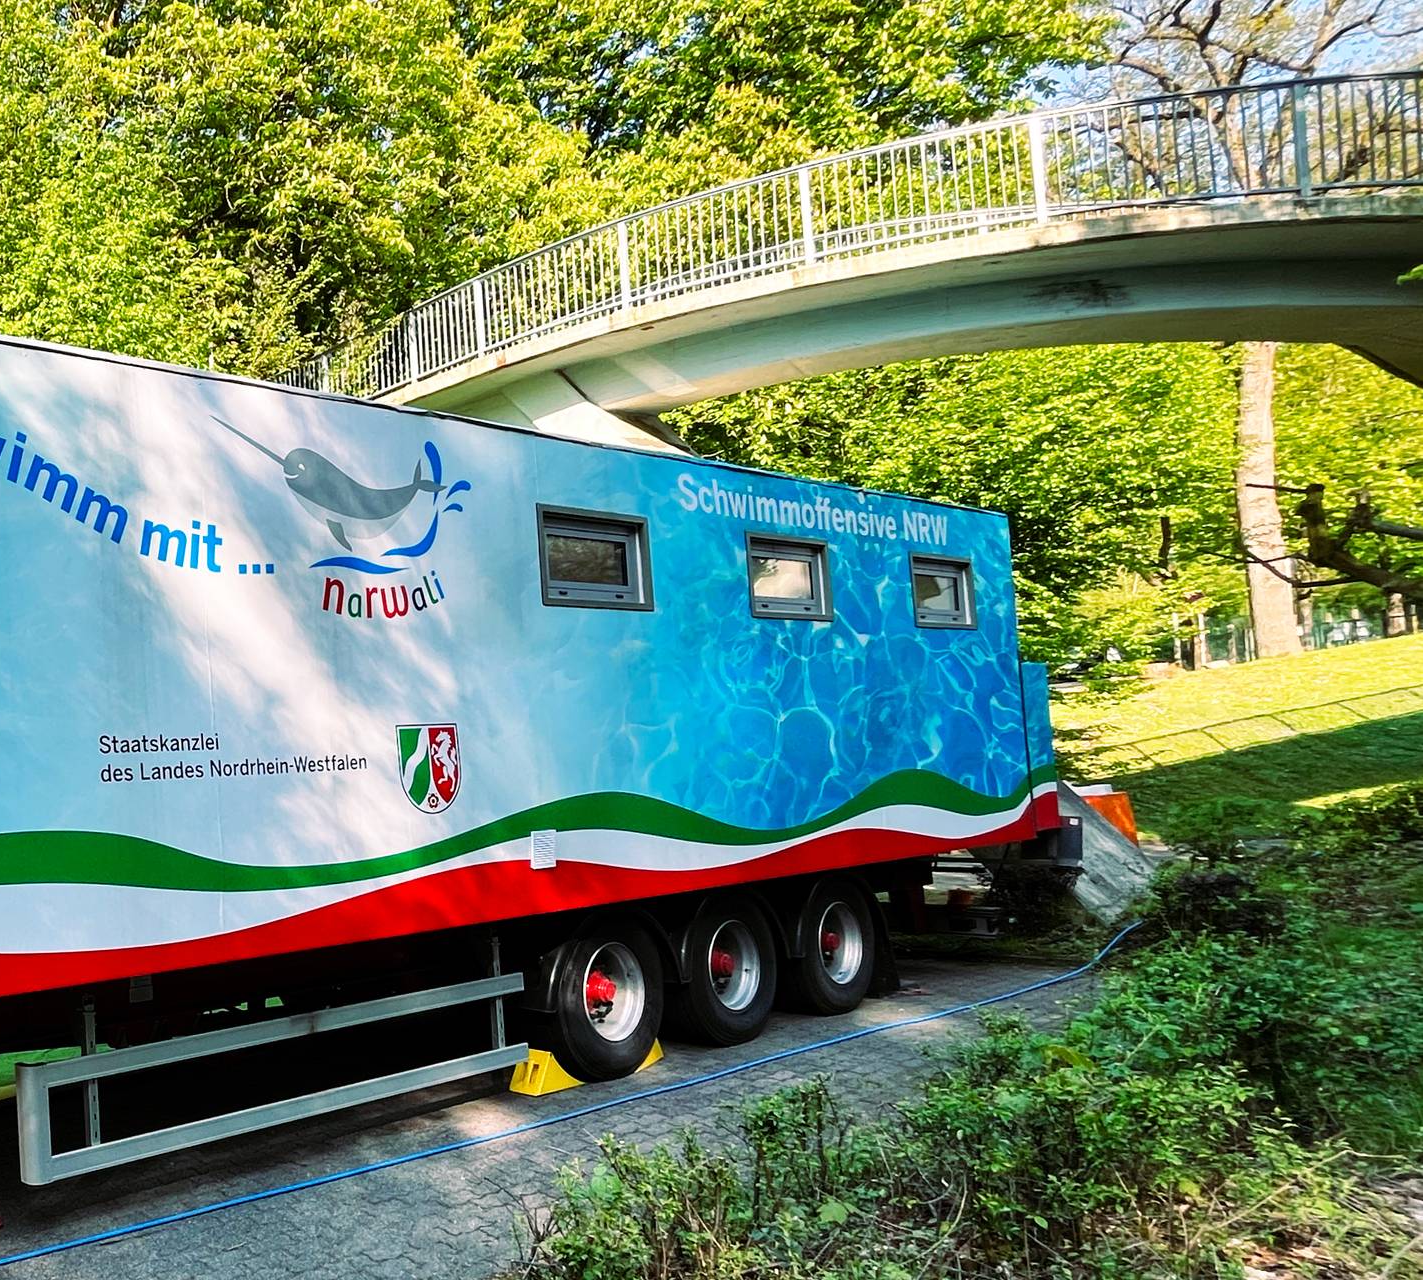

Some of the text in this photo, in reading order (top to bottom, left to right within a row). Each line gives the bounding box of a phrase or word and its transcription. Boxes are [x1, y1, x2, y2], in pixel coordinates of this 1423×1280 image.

[678, 473, 948, 546] Schwimmoffensive NRW
[140, 519, 223, 574] mit
[322, 570, 445, 619] narwali
[99, 733, 219, 754] Staatskanzlei
[100, 754, 368, 782] des Landes Nordrhein-Westfalen
